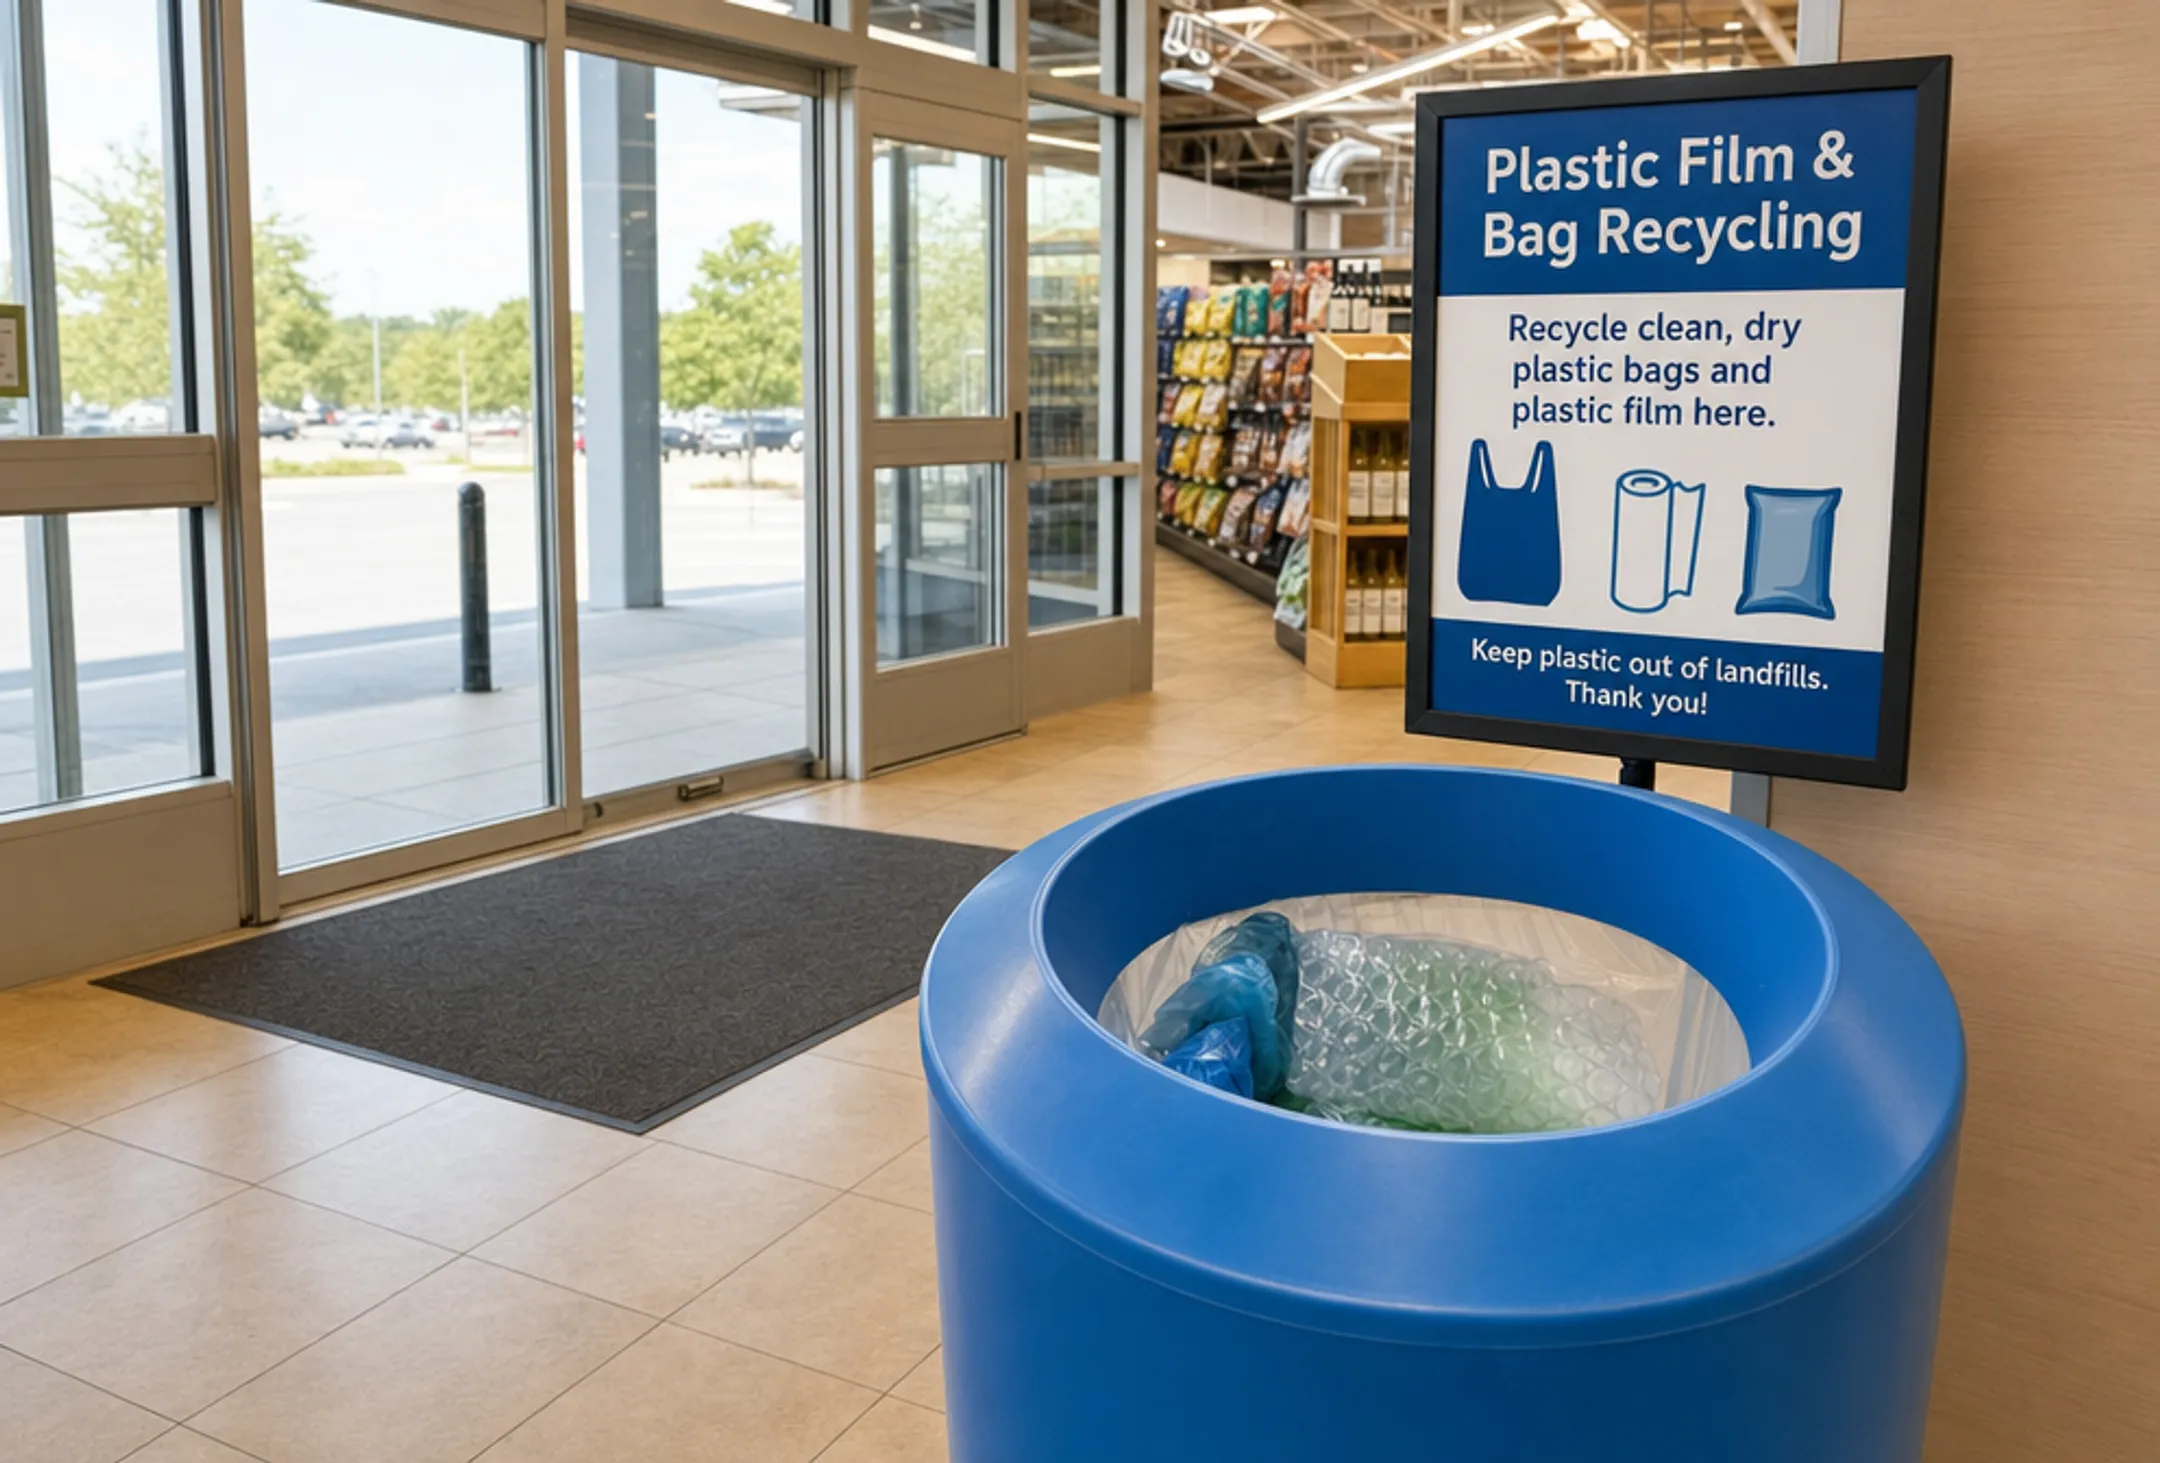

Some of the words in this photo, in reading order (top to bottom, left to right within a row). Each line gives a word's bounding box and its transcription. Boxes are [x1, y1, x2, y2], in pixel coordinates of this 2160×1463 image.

[1487, 139, 1659, 194] Plastic
[1679, 134, 1794, 186] Film
[1813, 130, 1855, 180] &
[1484, 211, 1578, 269] Bag
[1598, 199, 1862, 265] Recycling
[1509, 312, 1628, 349] Recycle
[1638, 311, 1732, 346] clean,
[1744, 310, 1802, 349] dry
[1513, 353, 1613, 389] plastic
[1624, 354, 1700, 392] bags
[1710, 354, 1772, 385] and
[1512, 394, 1613, 430] plastic
[1623, 395, 1683, 426] film
[1694, 396, 1775, 427] here.
[1472, 638, 1533, 670] Keep
[1539, 644, 1621, 673] plastic
[1628, 655, 1673, 678] out
[1680, 656, 1709, 680] of
[1716, 657, 1829, 690] landfills.
[1565, 679, 1643, 709] Thank
[1651, 691, 1707, 717] you!
